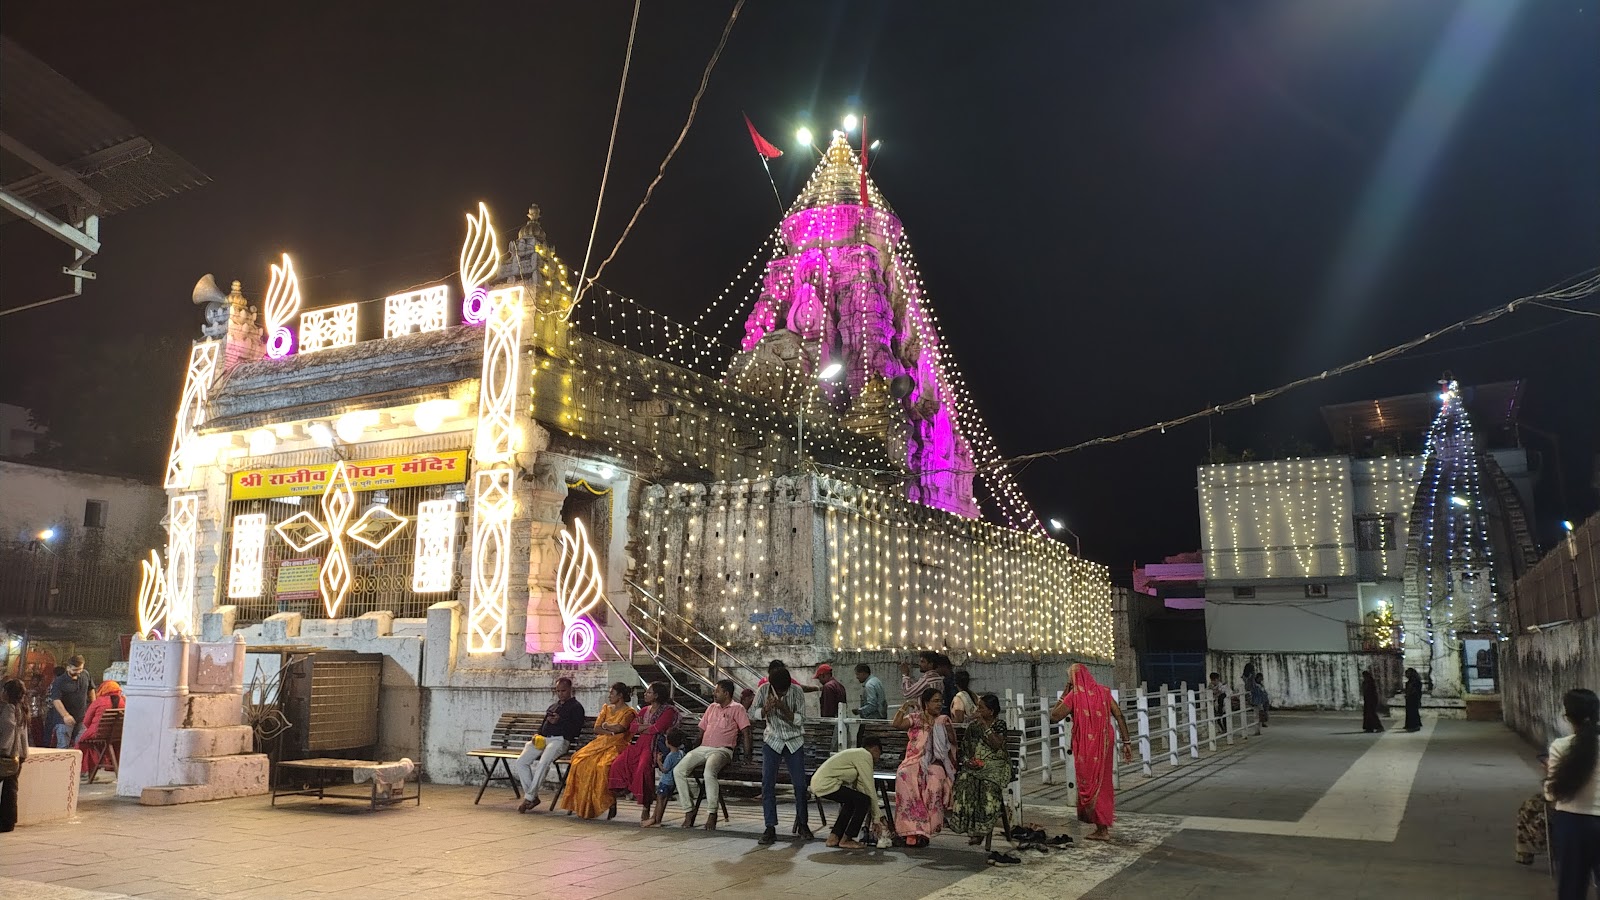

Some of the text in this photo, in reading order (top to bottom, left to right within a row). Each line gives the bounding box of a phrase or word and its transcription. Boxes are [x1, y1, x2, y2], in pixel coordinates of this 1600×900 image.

[240, 473, 264, 487] श्री
[268, 468, 327, 485] राजीव
[401, 456, 458, 473] मंदिर
